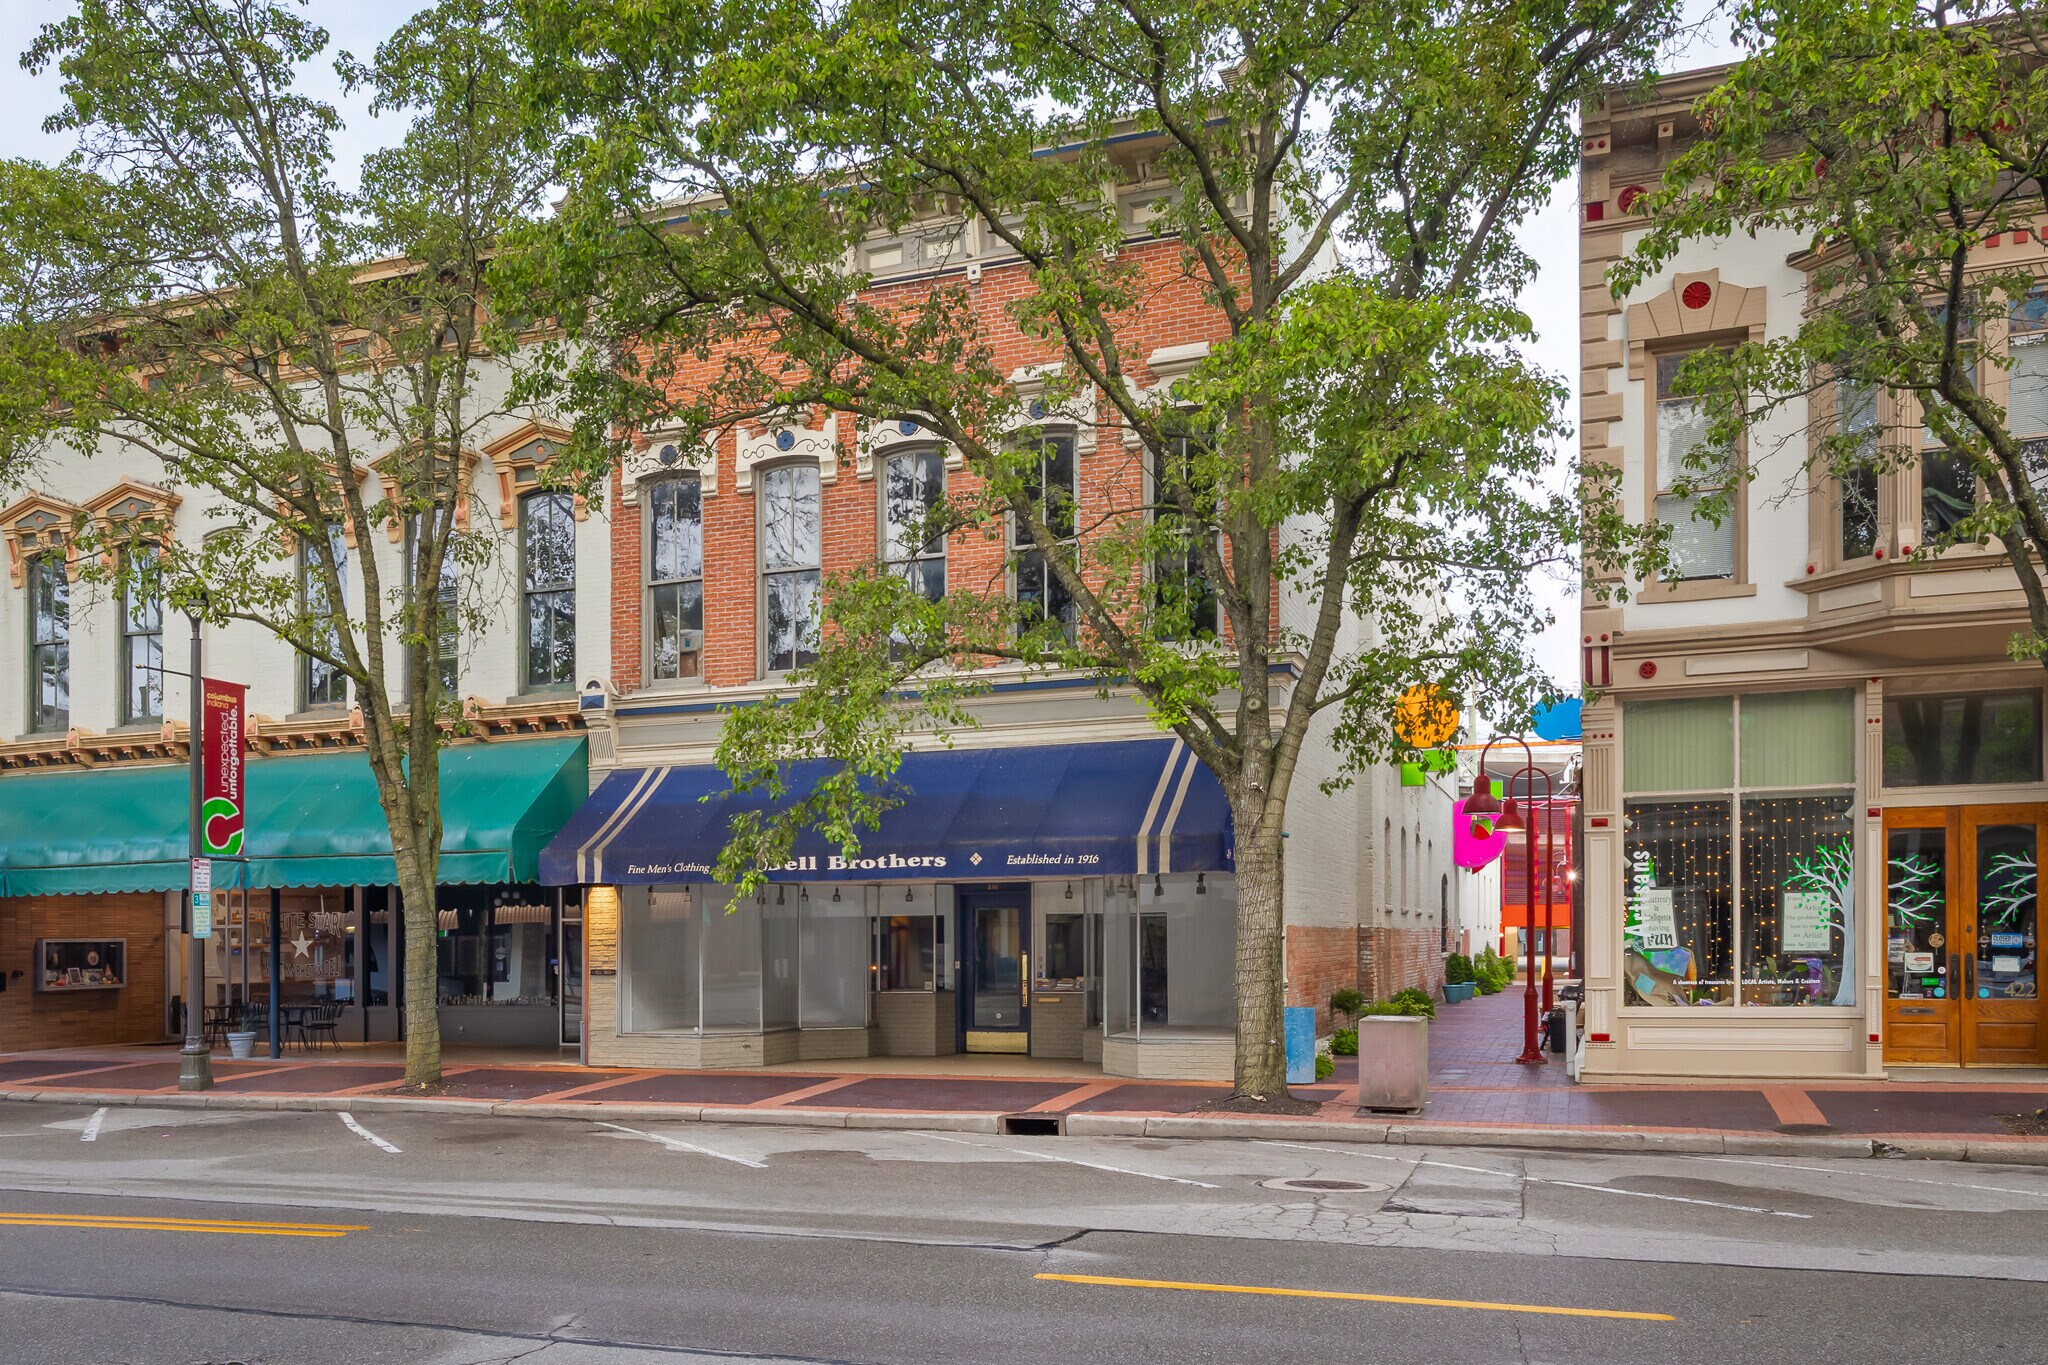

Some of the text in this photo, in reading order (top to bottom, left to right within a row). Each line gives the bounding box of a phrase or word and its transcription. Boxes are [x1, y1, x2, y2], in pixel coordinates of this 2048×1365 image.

[206, 692, 238, 704] columbus
[206, 699, 229, 709] indiana
[220, 710, 231, 793] unexpected.
[230, 705, 239, 800] unforgettable.
[827, 853, 947, 870] Brothers
[1006, 854, 1099, 865] Established in 1916
[627, 862, 710, 874] Fine Men's Clothing
[1624, 850, 1650, 937] Artisans
[2004, 982, 2037, 997] 422
